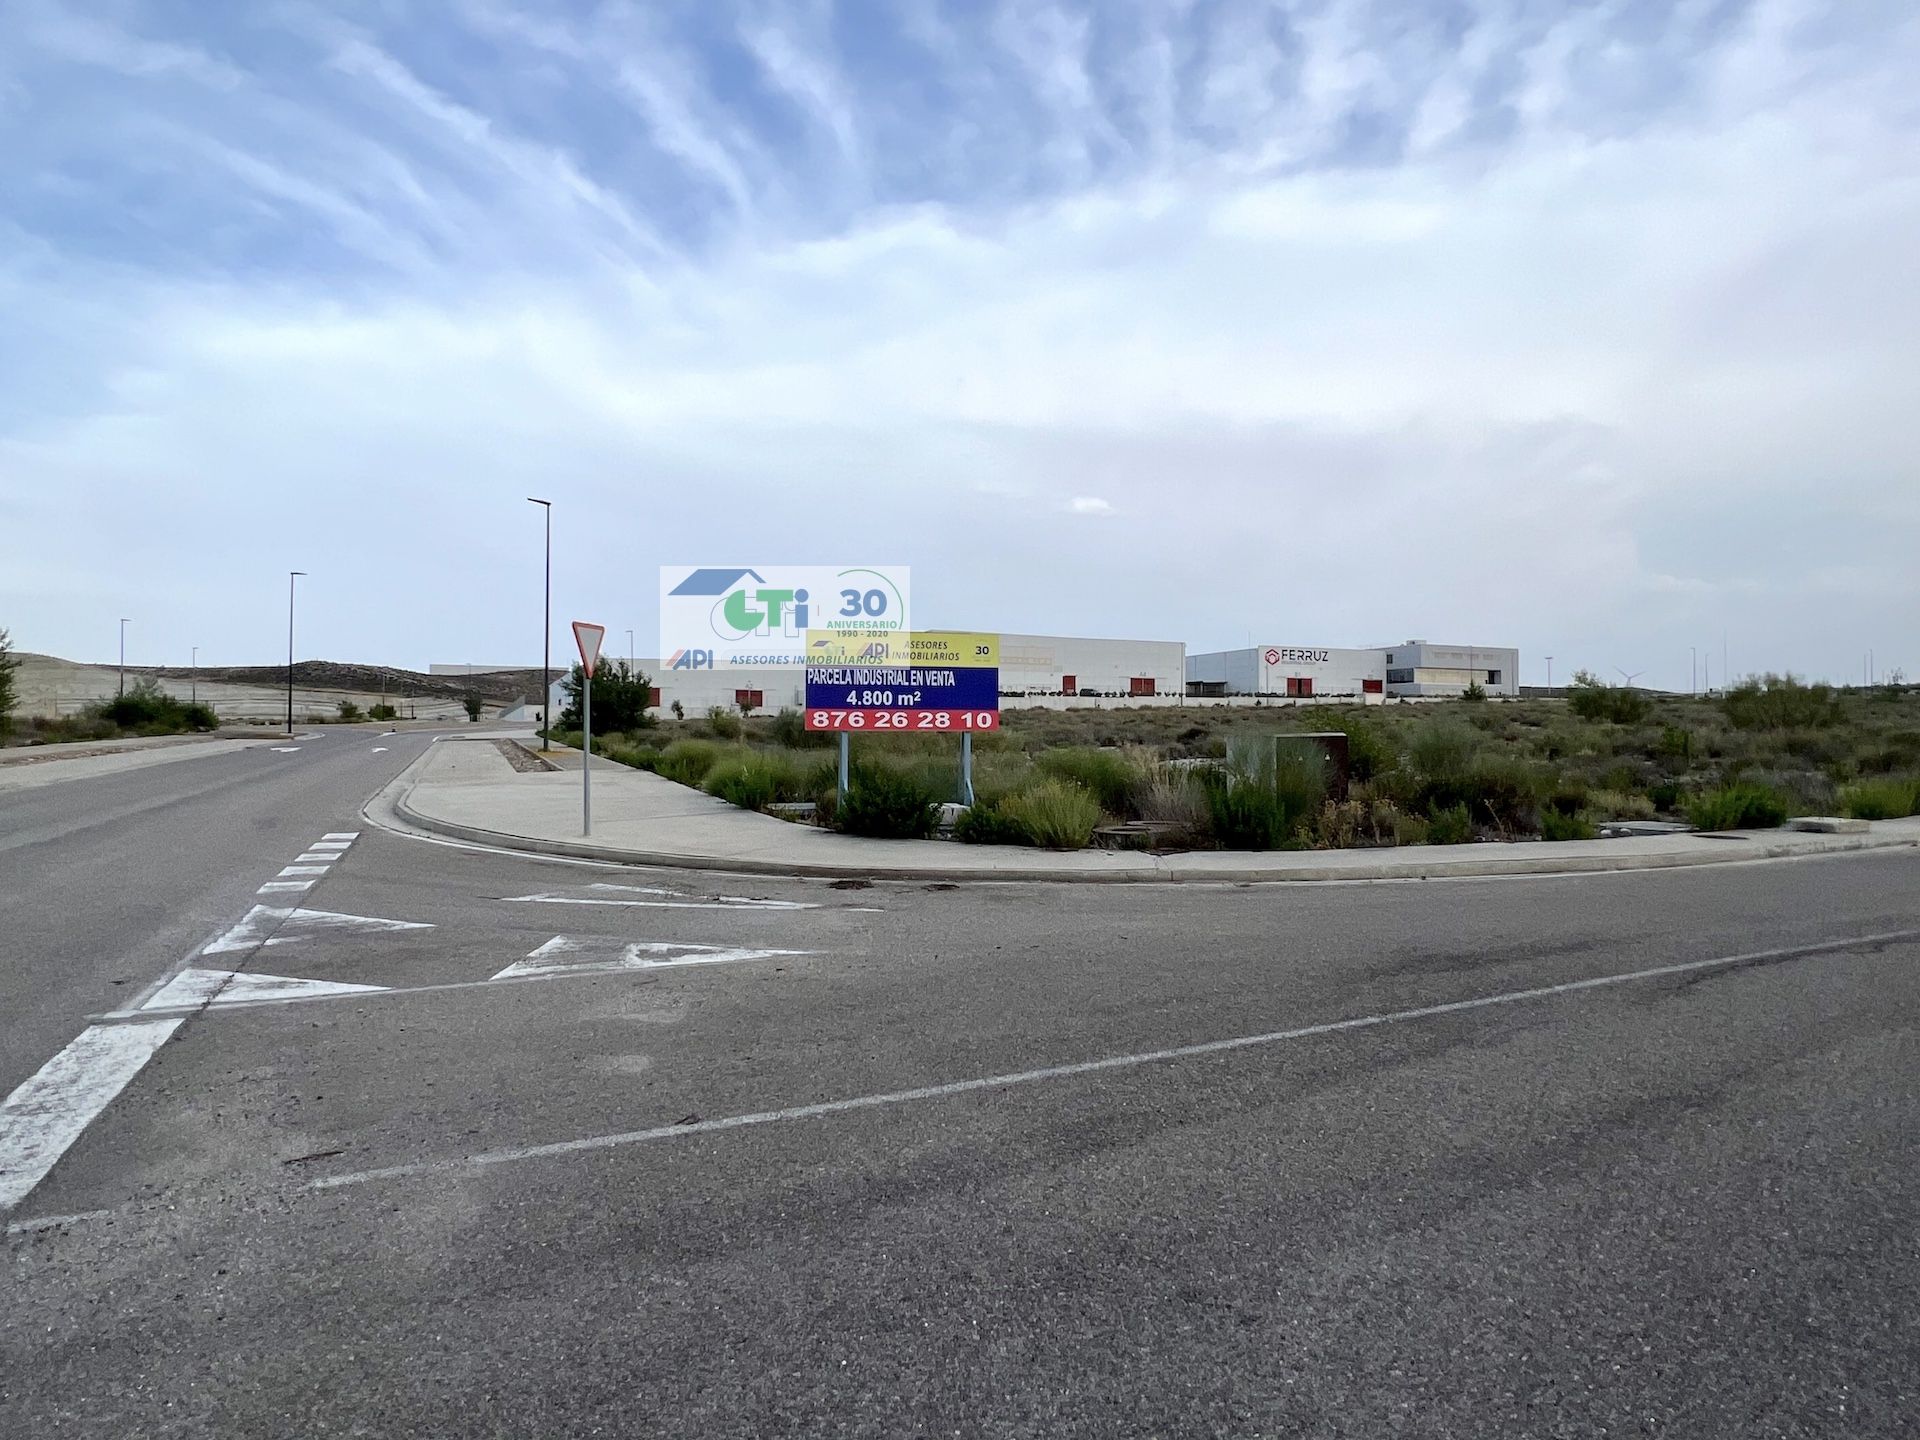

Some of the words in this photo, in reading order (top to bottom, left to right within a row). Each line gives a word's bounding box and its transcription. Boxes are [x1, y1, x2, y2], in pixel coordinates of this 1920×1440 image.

[862, 642, 889, 659] API
[904, 640, 948, 650] ASESORES
[975, 645, 990, 655] 30
[892, 651, 960, 661] INMOBILIARIOS
[1281, 649, 1328, 661] FERRUZ
[807, 668, 852, 685] PARCELA
[853, 669, 909, 686] INDUSTRIAL
[910, 670, 924, 686] EN
[925, 670, 956, 687] VENTA
[846, 690, 893, 706] 4.800
[812, 711, 865, 728] 876
[874, 711, 909, 728] 26
[917, 712, 951, 729] 28
[960, 712, 992, 729] 10
